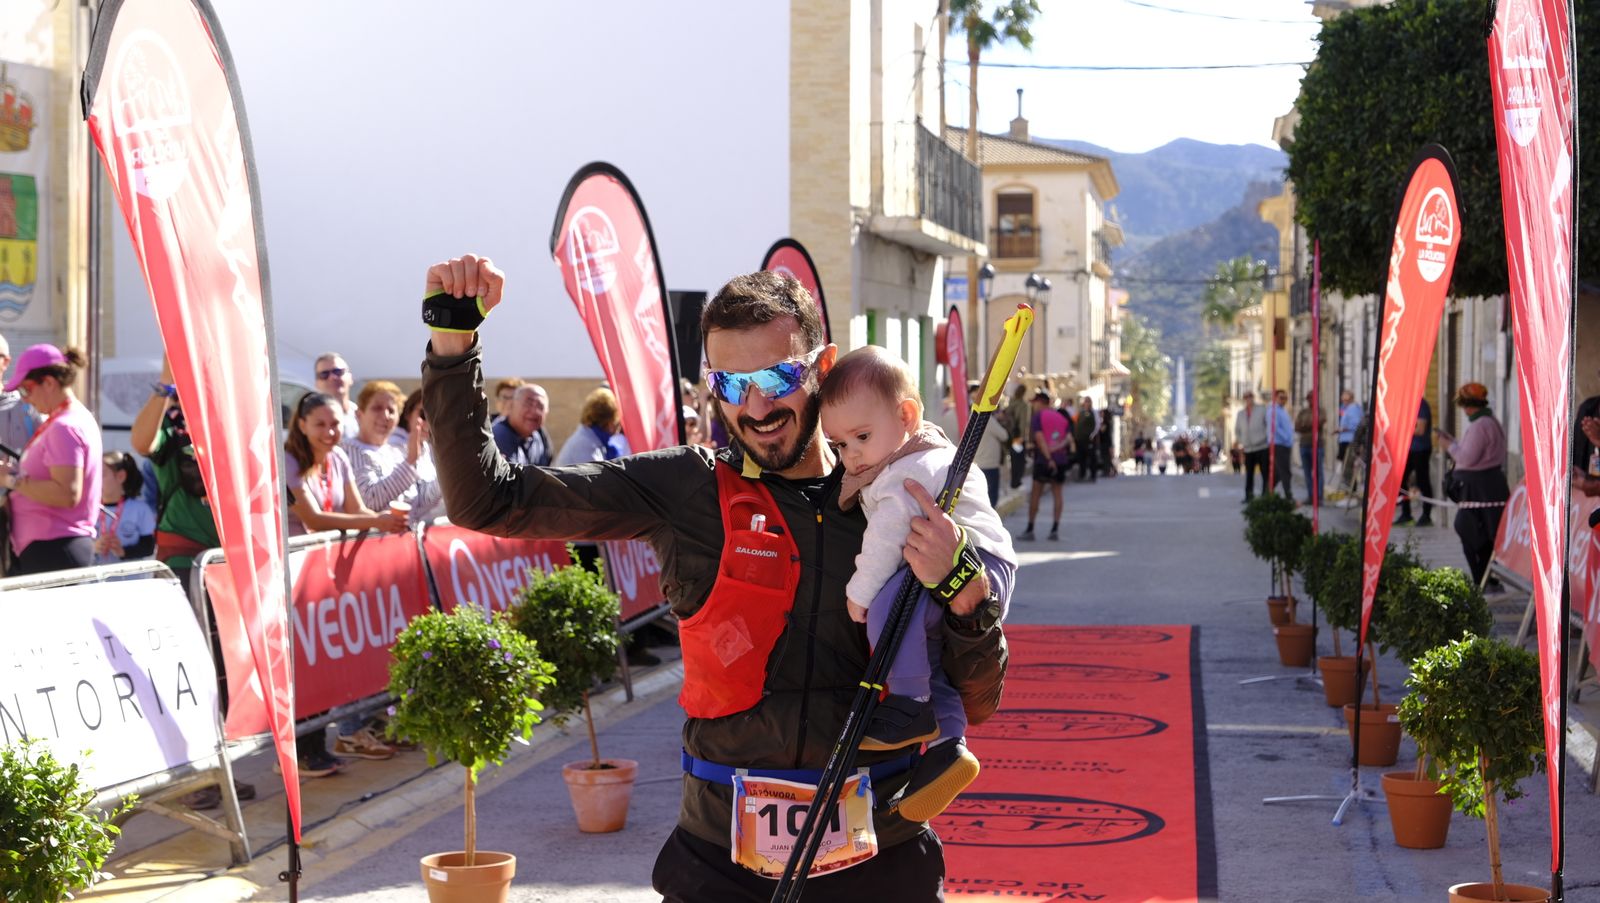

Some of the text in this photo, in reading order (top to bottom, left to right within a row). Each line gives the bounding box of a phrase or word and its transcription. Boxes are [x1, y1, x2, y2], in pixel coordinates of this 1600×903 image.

[735, 547, 777, 558] SALOMON
[940, 563, 974, 598] LEKI
[292, 583, 408, 667] VEOLIA
